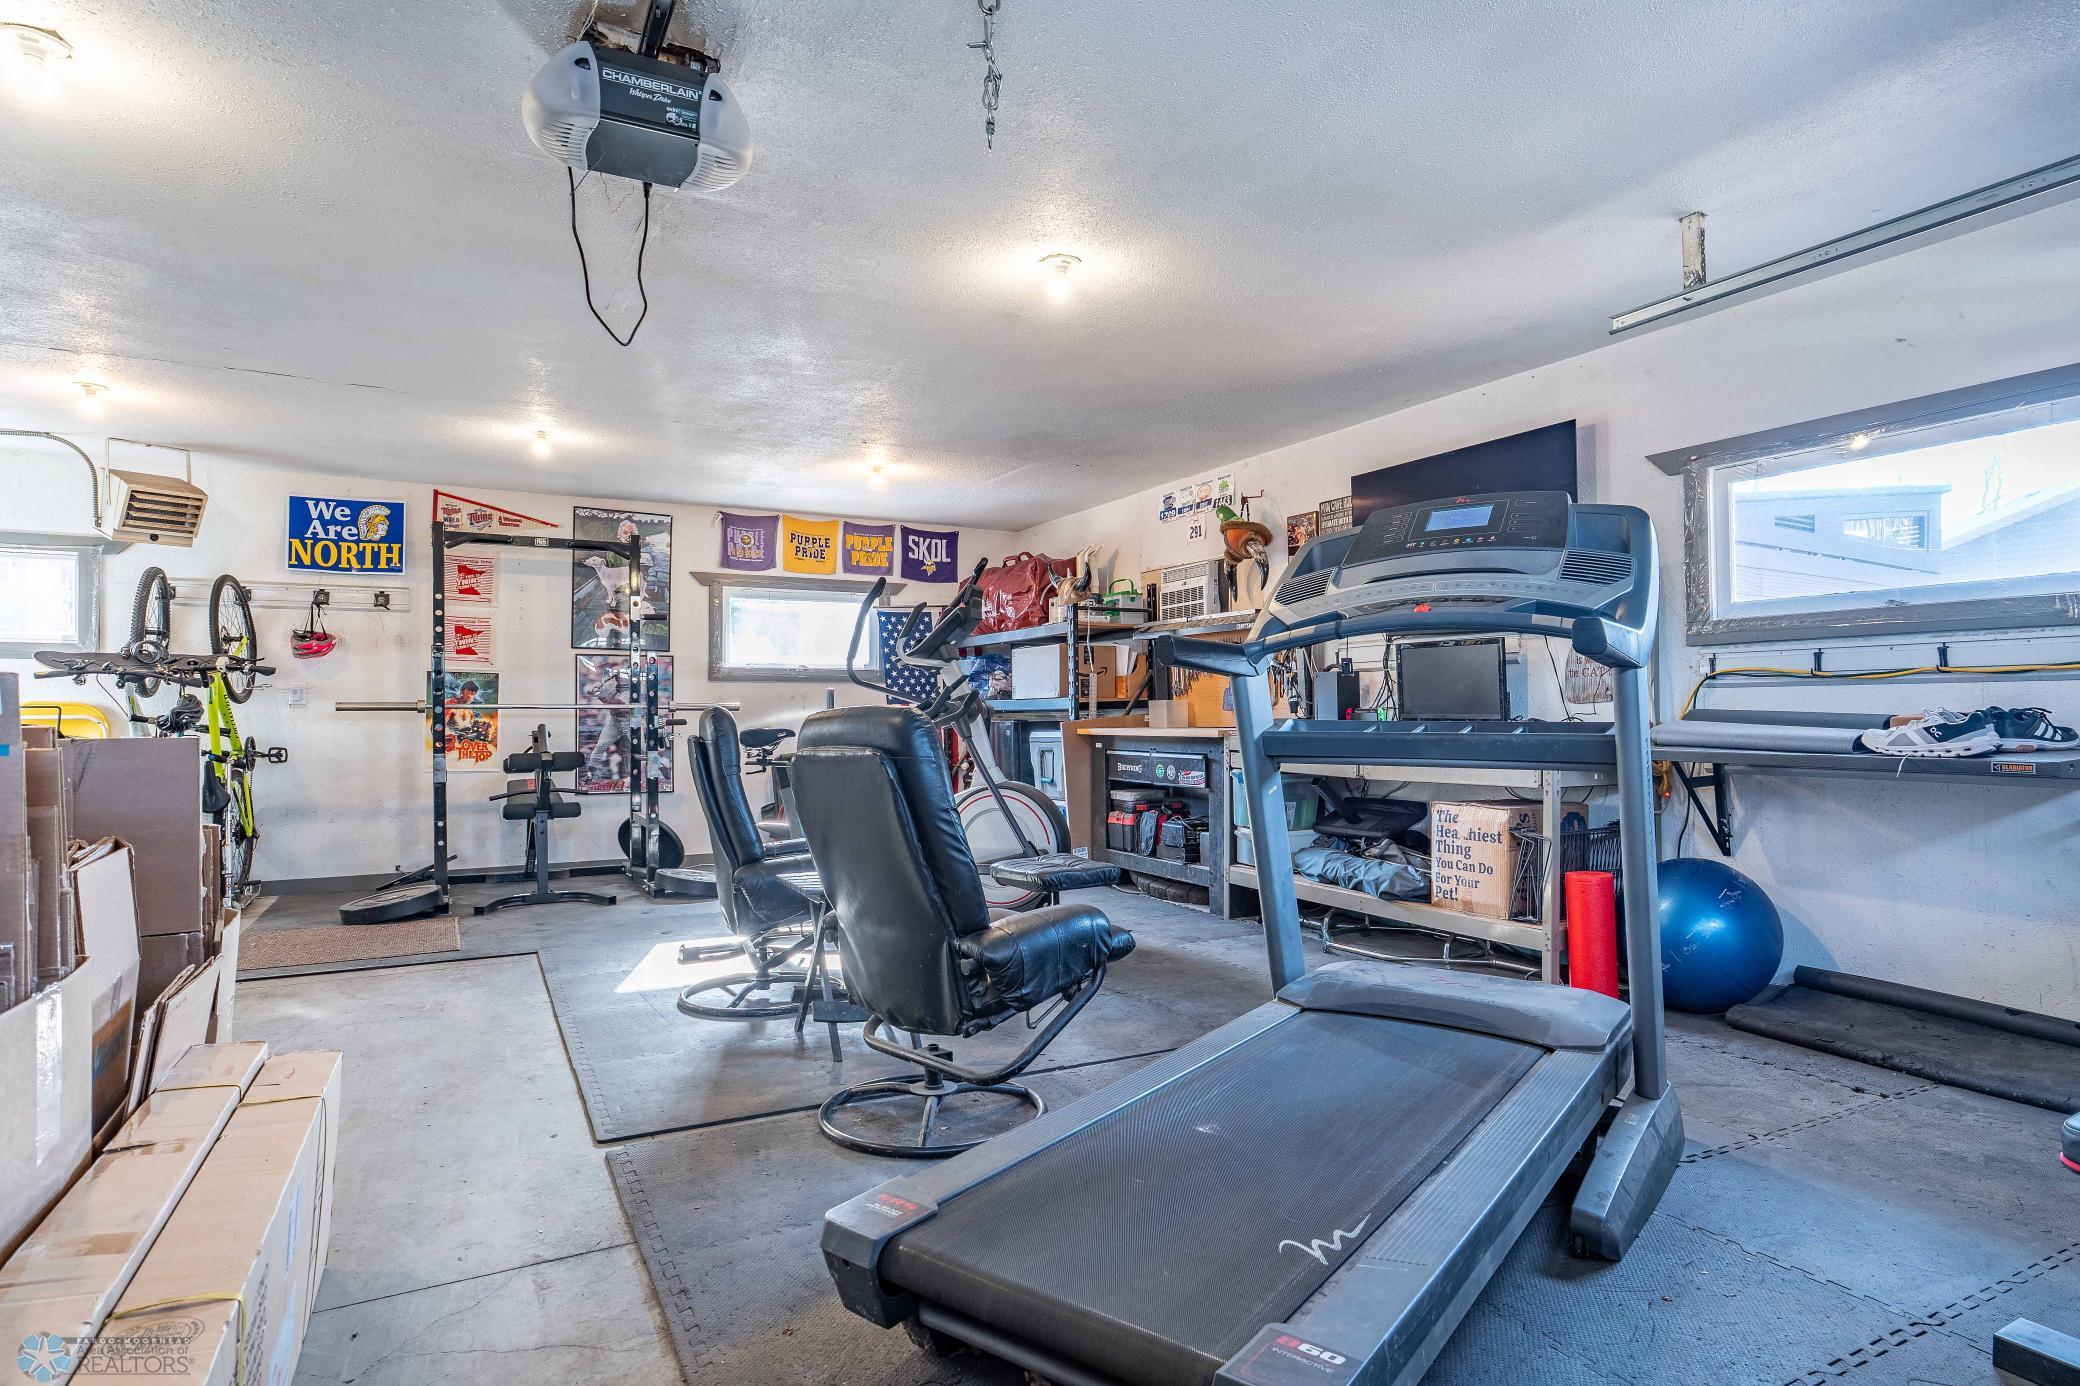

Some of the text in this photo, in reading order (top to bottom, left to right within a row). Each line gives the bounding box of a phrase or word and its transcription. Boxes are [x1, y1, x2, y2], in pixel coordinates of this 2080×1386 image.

[305, 500, 351, 521] We
[304, 519, 358, 540] Are
[790, 532, 831, 549] PURPLE
[845, 533, 894, 552] PURPLE
[908, 535, 951, 563] SKOL
[289, 538, 401, 569] NORTH
[794, 545, 826, 560] PRIDE
[851, 550, 889, 567] PRIDE
[1569, 669, 1579, 678] the
[461, 739, 489, 752] OVER
[456, 748, 493, 764] THE TOP
[2001, 763, 2033, 772] GLADIATOR
[1437, 809, 1459, 824] The
[1436, 824, 1503, 844] Heahiest
[1436, 839, 1472, 860] Thing
[1436, 857, 1494, 875] You Can Do
[1436, 872, 1480, 889] For Your
[1435, 885, 1458, 901] Pet!
